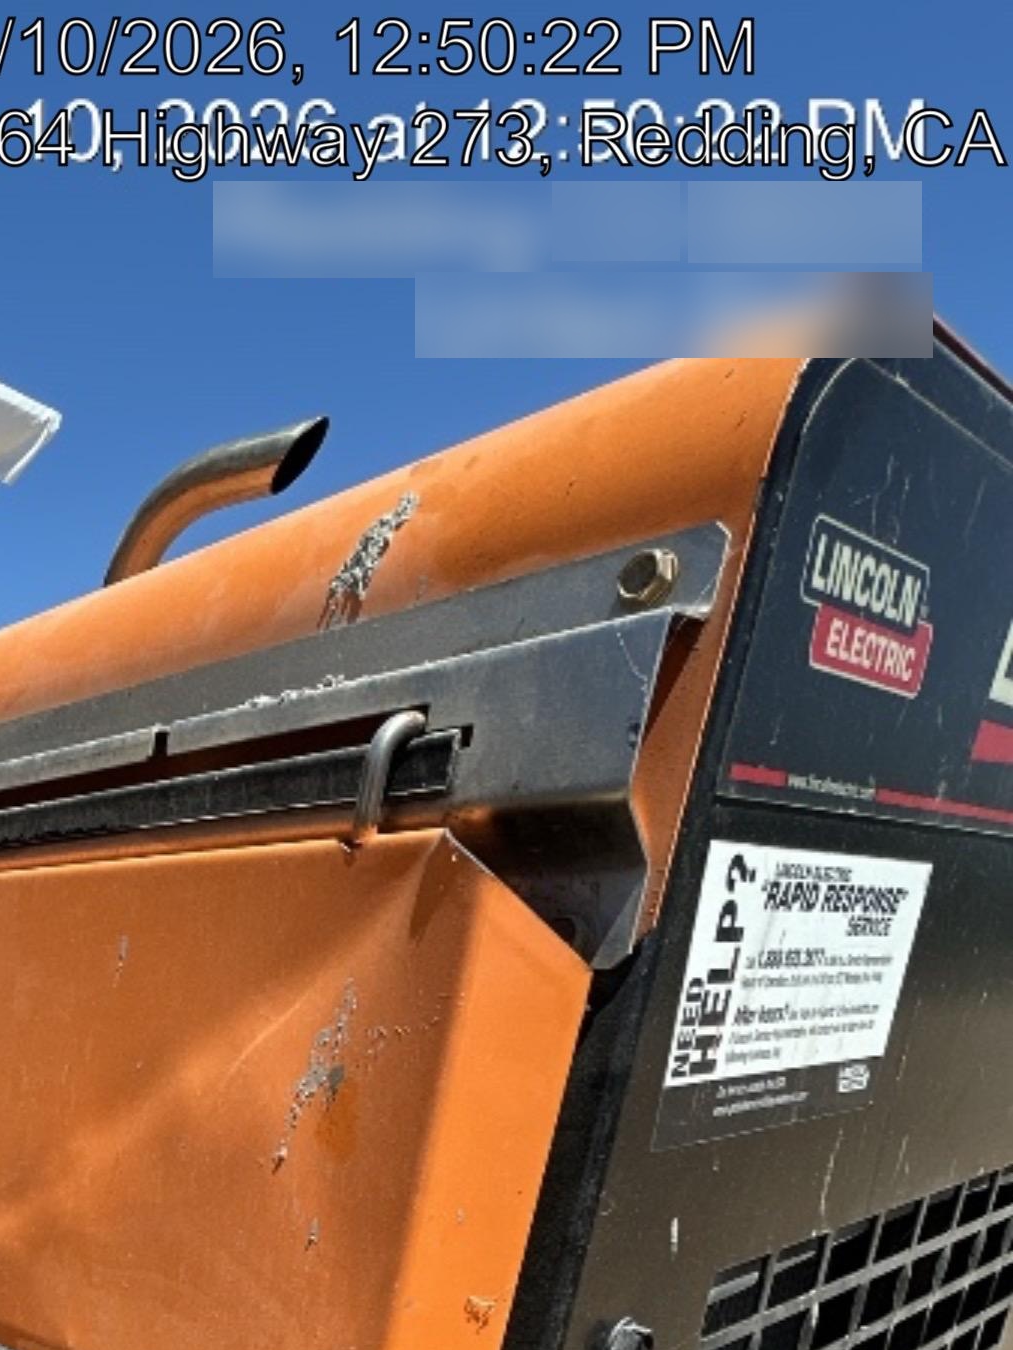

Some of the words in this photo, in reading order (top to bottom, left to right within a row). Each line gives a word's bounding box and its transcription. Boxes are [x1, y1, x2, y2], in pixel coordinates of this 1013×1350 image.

[811, 533, 922, 628] LINCOLN
[825, 618, 917, 682] ELECTRIC
[688, 853, 757, 1077] HELP?
[845, 915, 894, 937] SERVICE
[670, 977, 706, 1078] NEED
